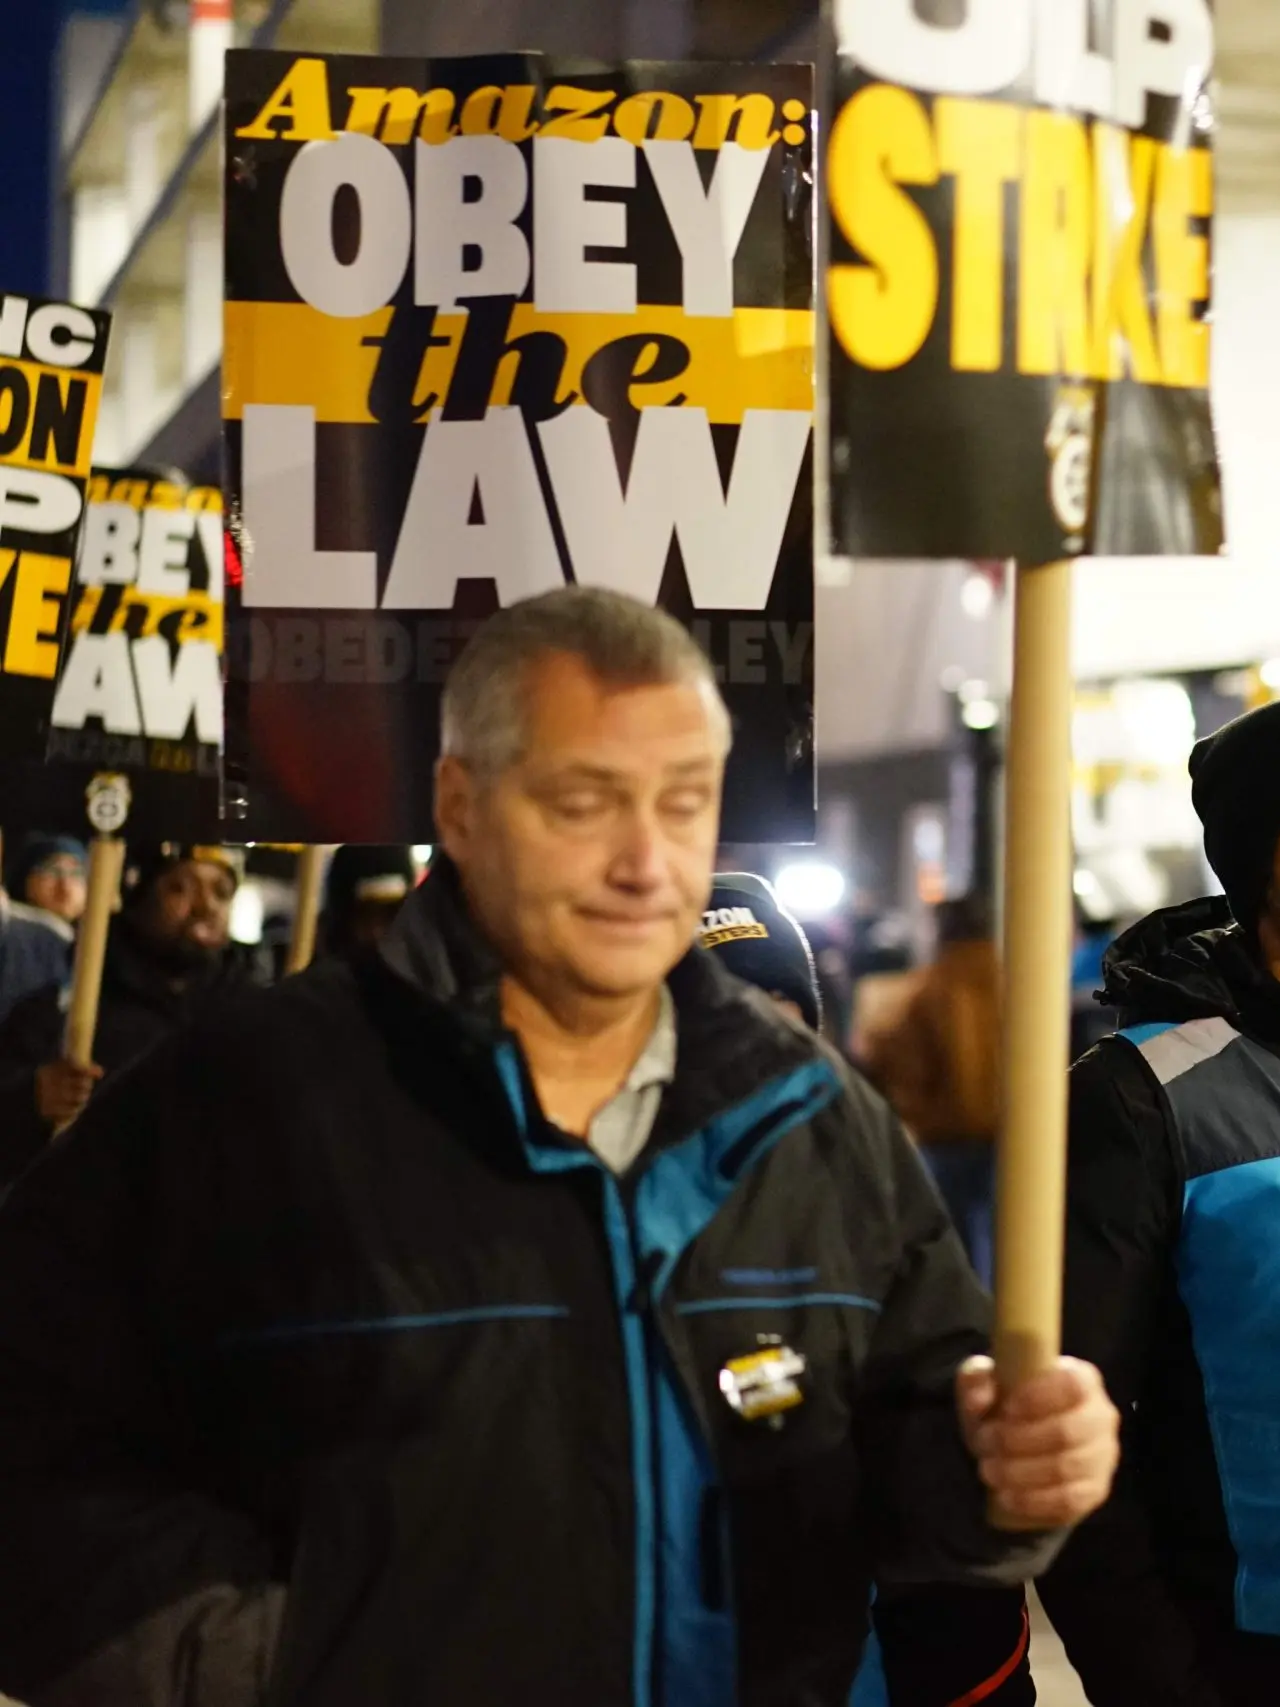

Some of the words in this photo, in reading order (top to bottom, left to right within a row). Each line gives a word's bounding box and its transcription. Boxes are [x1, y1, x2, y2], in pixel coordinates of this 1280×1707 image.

[235, 58, 806, 152] Amazon:
[279, 131, 772, 318] OBEY
[360, 294, 692, 424] the
[241, 403, 813, 611] LAW
